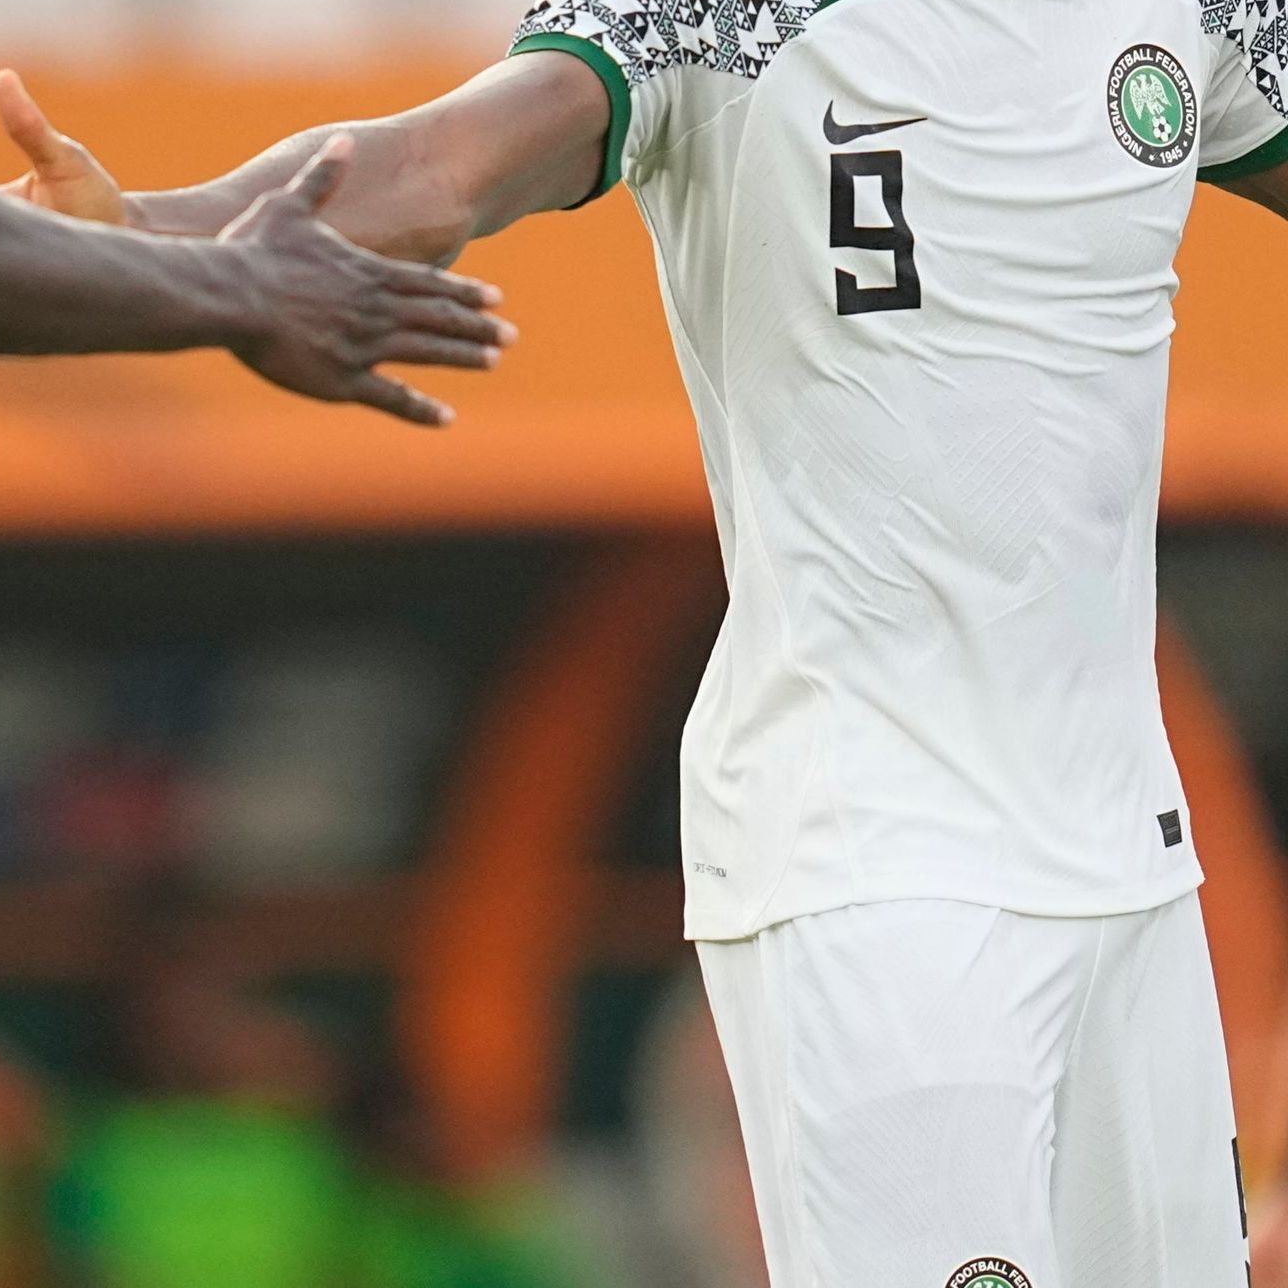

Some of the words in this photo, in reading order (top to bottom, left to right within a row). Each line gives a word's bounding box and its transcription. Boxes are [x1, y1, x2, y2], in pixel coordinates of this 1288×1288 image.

[1109, 48, 1154, 98] FOOTBALL
[1155, 51, 1195, 137] FEDERATION
[1109, 101, 1143, 156] NIGERIA
[1159, 145, 1183, 164] 1945
[830, 150, 921, 315] 9
